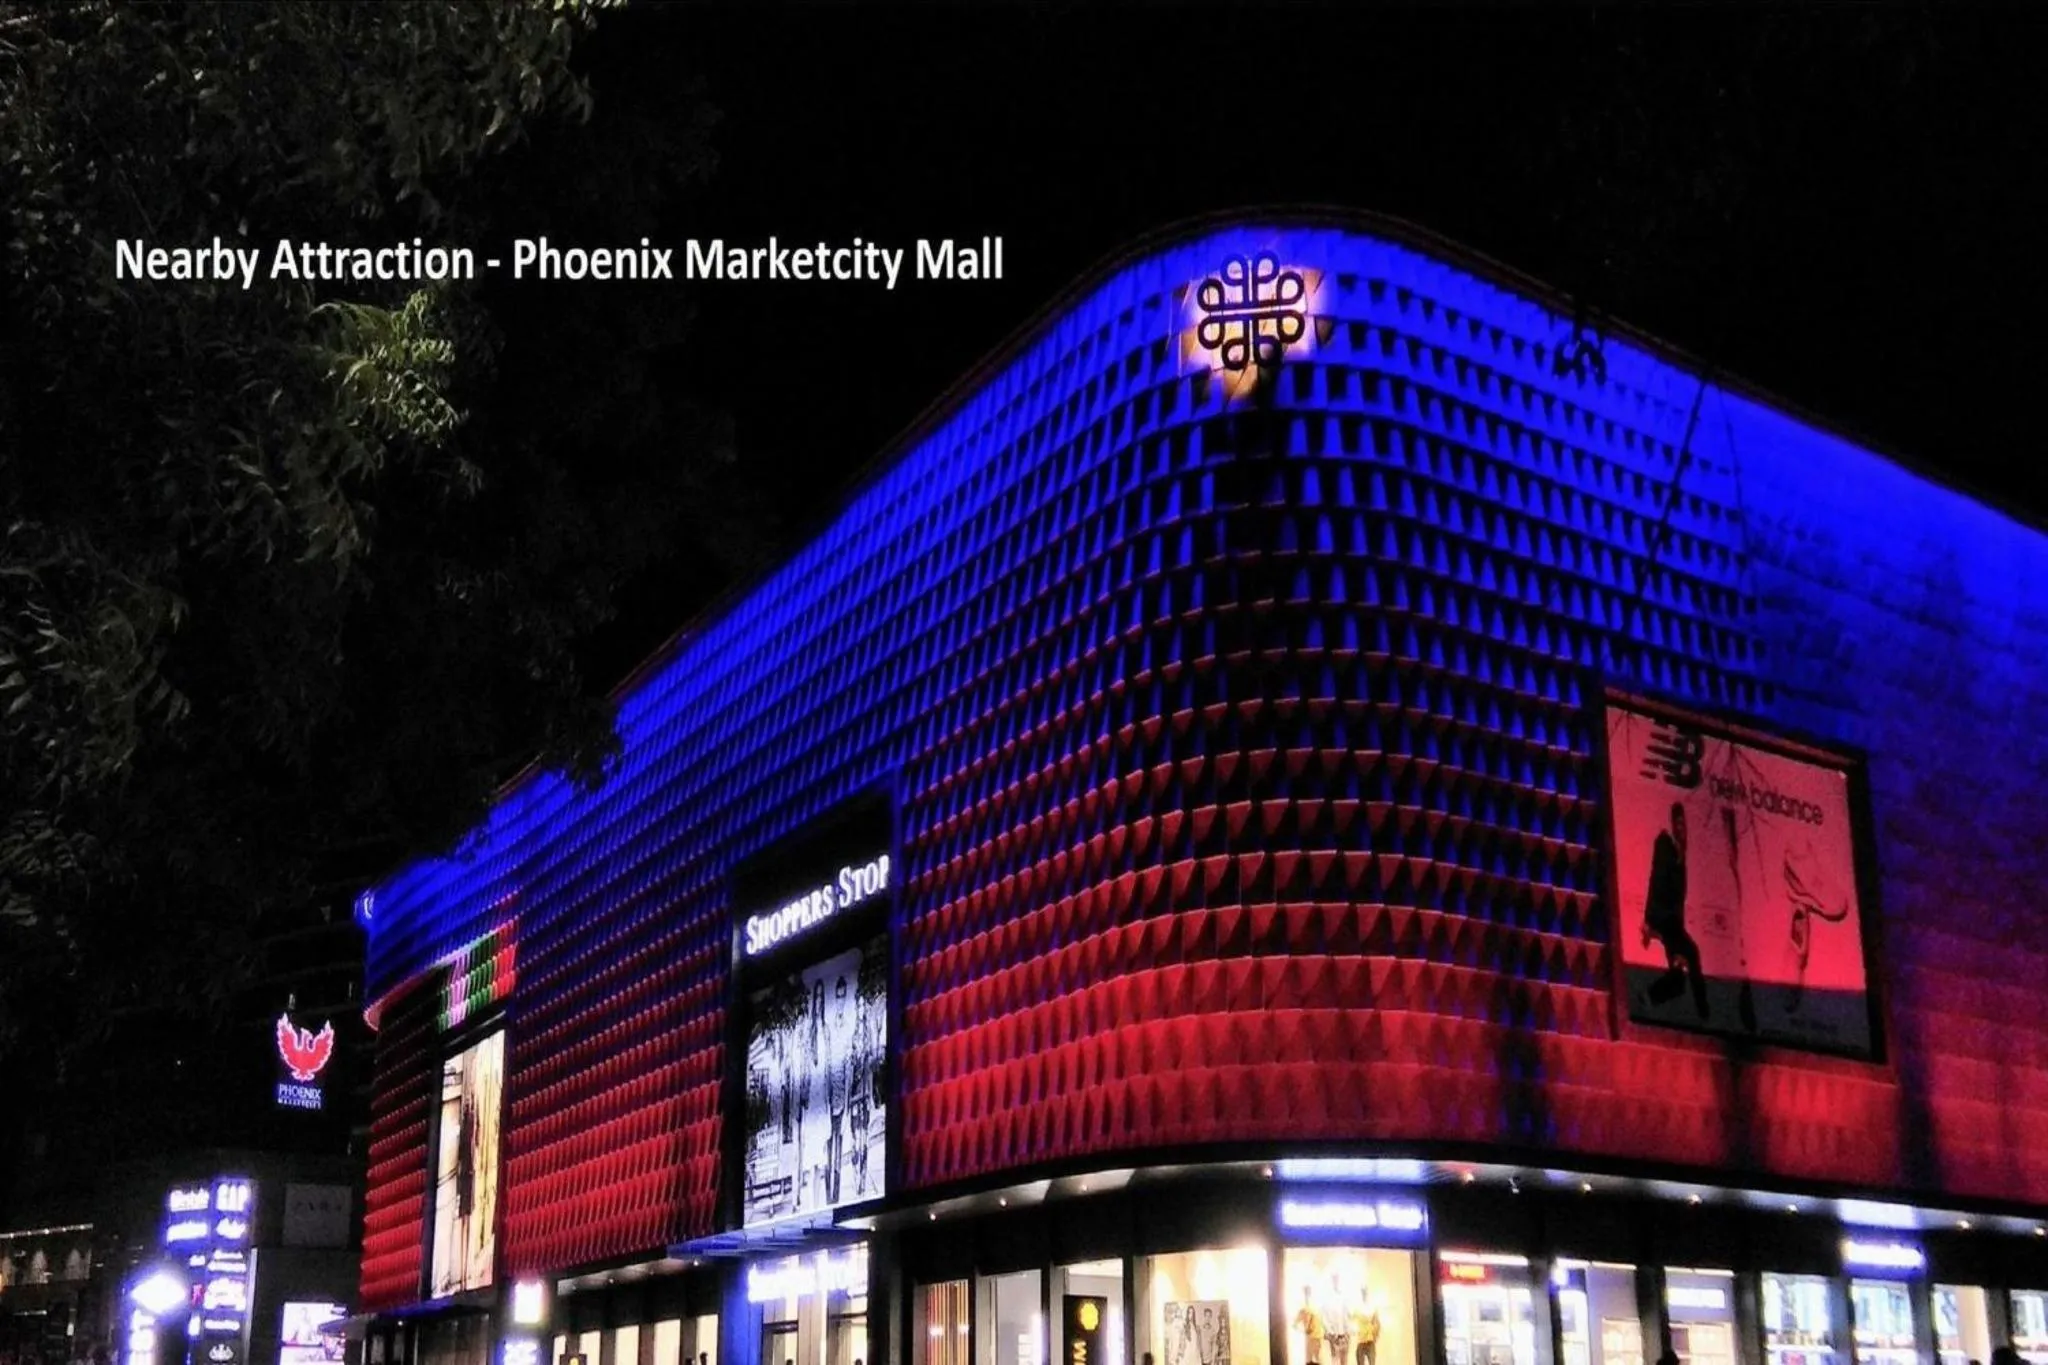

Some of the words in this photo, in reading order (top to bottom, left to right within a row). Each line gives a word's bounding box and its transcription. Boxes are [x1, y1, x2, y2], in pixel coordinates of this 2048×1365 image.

[1750, 781, 1825, 826] balance
[746, 884, 834, 955] SHOPPERS
[838, 854, 890, 908] STOP
[278, 1083, 322, 1101] PHOENIX
